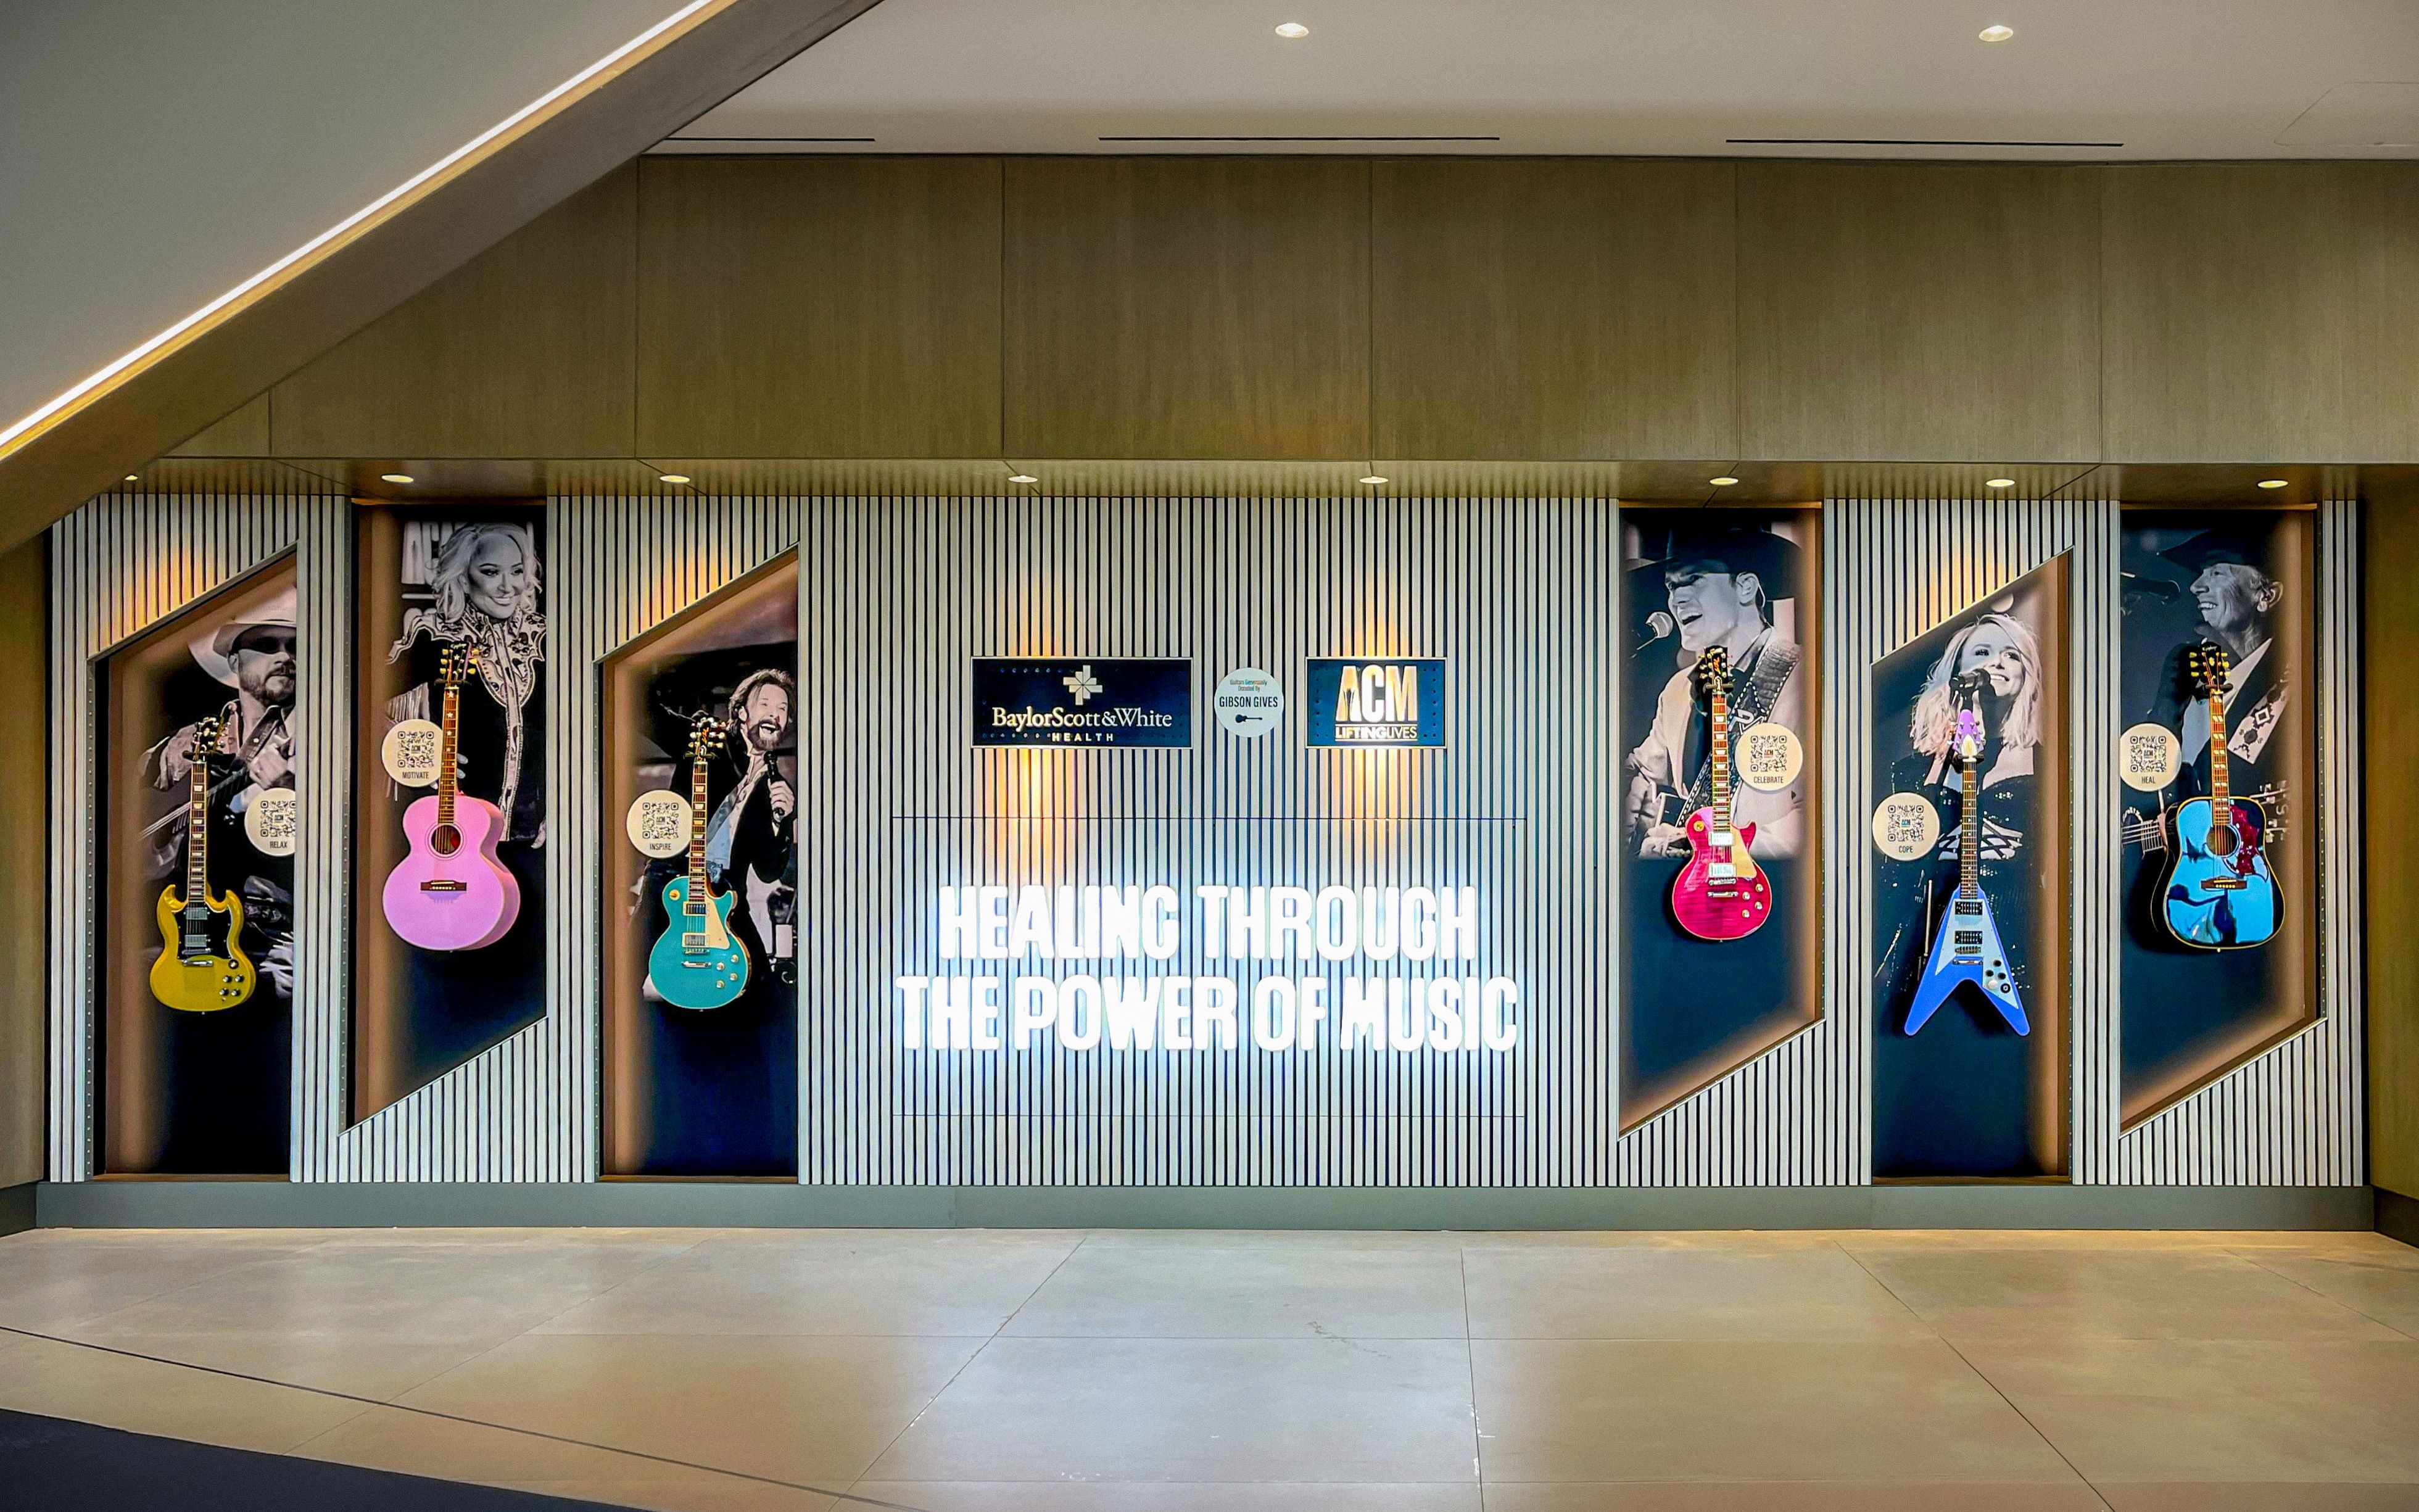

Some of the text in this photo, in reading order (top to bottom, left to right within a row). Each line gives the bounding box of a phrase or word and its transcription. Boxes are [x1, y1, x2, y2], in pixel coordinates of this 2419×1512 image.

[1219, 696, 1278, 708] GIBSON GIVES
[1336, 664, 1417, 722] ACM
[1052, 733, 1114, 742] HEALTH
[940, 885, 1476, 960] HEALING THROUGH
[896, 975, 1518, 1051] THE POWER OF MUSIC
